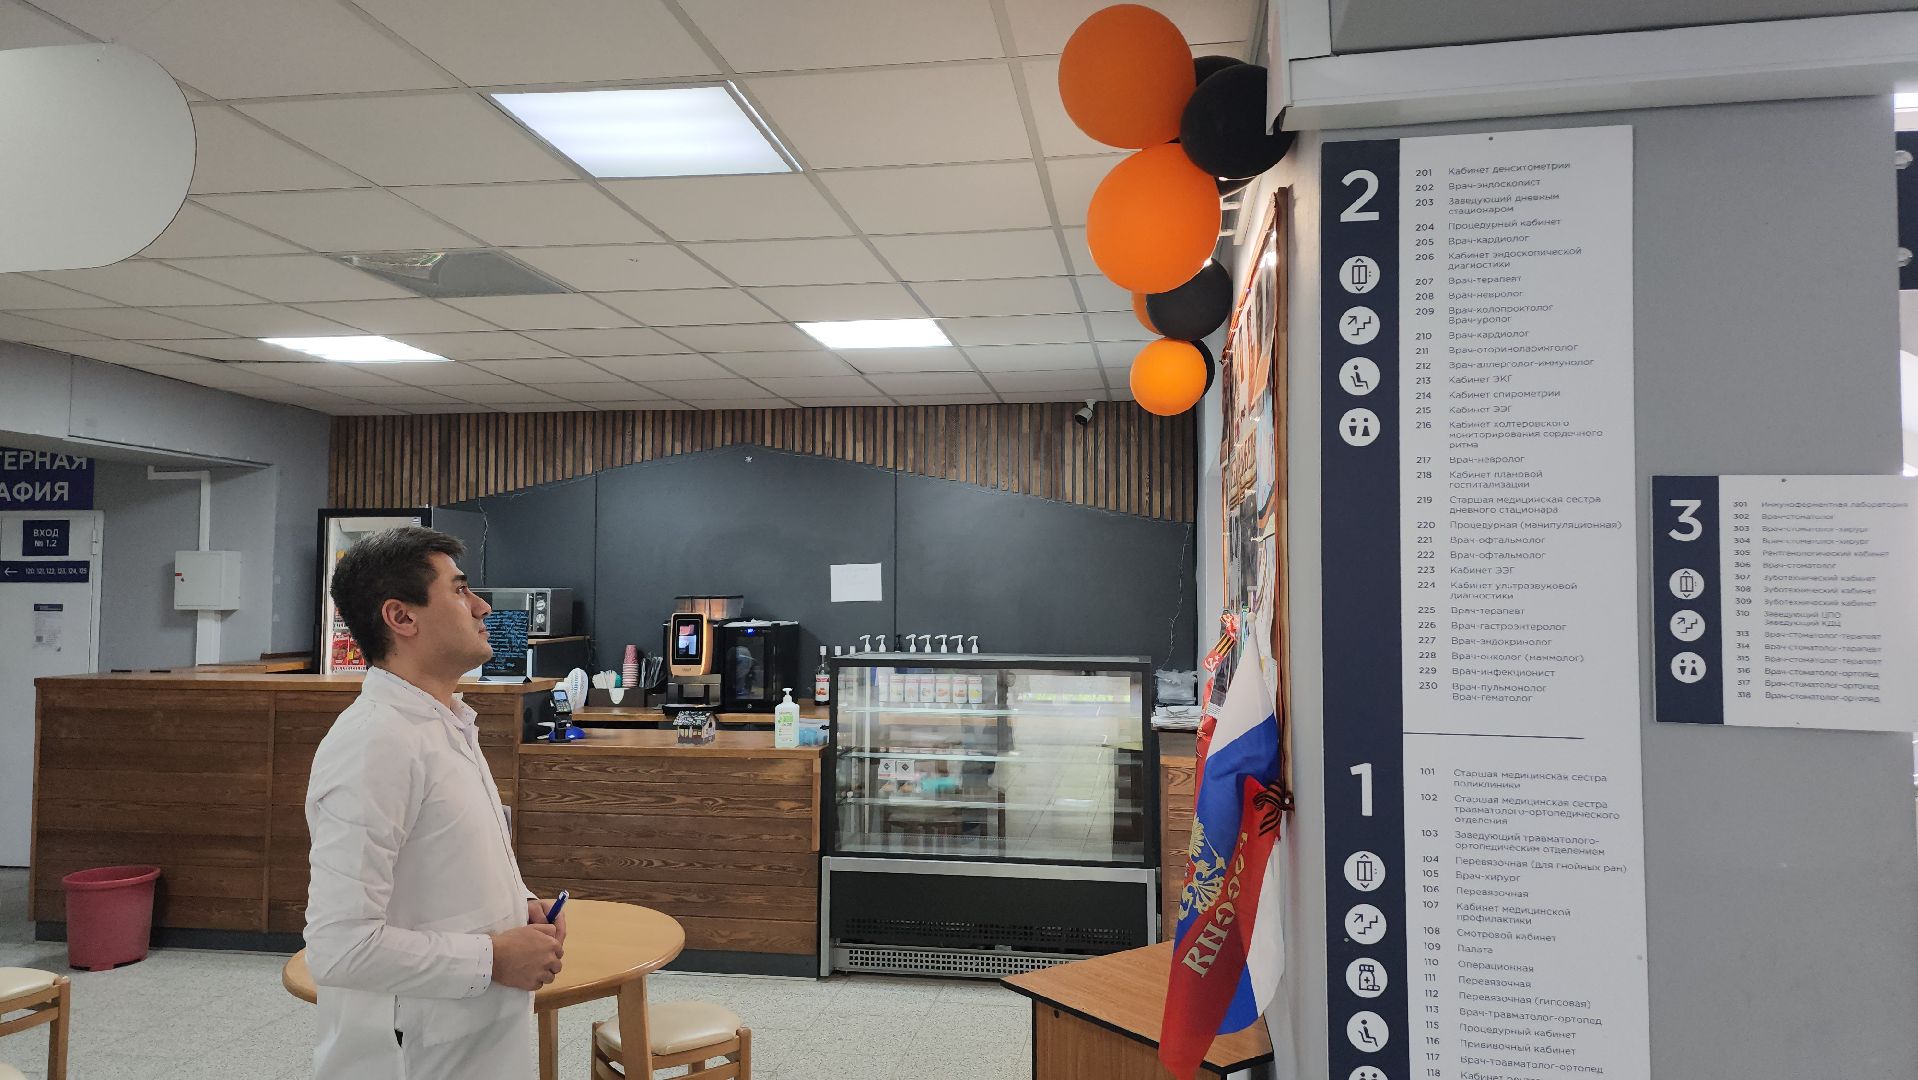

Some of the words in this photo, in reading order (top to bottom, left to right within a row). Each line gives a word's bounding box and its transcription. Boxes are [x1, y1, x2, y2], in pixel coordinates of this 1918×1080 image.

[1449, 167, 1489, 175] Кабинет
[1340, 170, 1380, 222] 2
[1416, 199, 1434, 207] 203
[1416, 223, 1434, 231] 204
[1449, 222, 1517, 231] Процедурный
[1416, 239, 1434, 247] 205
[1449, 236, 1530, 245] Врач-кардиолог
[1448, 262, 1510, 270] диагностики
[1448, 276, 1521, 285] Врач-терапевт
[1449, 292, 1523, 300] Врач-невролог
[1416, 308, 1435, 316] 209
[1449, 305, 1553, 315] Врач-колопроктолог
[1449, 316, 1512, 325] Врач-уролог
[1449, 331, 1528, 341] Врач-кардиолог
[1493, 375, 1512, 383] ЭКГ
[1449, 391, 1490, 399] Кабинет
[1493, 391, 1560, 399] спирометрии
[1416, 407, 1431, 415] 215
[1416, 421, 1431, 429] 216
[0, 451, 87, 470] ЕРНАЯ
[1494, 470, 1543, 478] плановой
[1450, 496, 1493, 504] Старшая
[1668, 500, 1703, 541] 3
[1450, 521, 1517, 530] Процедурная
[34, 529, 59, 537] ВХОД
[1450, 536, 1545, 544] Врач-офтальмолог
[1450, 551, 1546, 560] Врач-офтальмолог
[1450, 566, 1492, 574] Кабинет
[1451, 607, 1523, 615] Врач-терапевт
[1452, 637, 1552, 646] Врач-эндокринолог
[1524, 654, 1584, 663] (маммолог)
[1736, 655, 1750, 663] 315
[1452, 668, 1555, 677] Врач-инфекционист
[1453, 683, 1547, 692] Врач-пульмонолог
[1453, 693, 1533, 701] Врач-гематолог
[1454, 769, 1497, 778] Старшая
[1571, 775, 1607, 783] сестра
[1350, 763, 1373, 816] 1
[1421, 793, 1438, 801] 102
[1455, 795, 1498, 804] Старшая
[1502, 798, 1569, 807] медицинская
[1573, 801, 1608, 809] сестра
[1455, 831, 1520, 841] Заведующий
[1543, 847, 1604, 855] отделением
[1456, 857, 1527, 867] Перевязочная
[1556, 863, 1600, 871] гнойных
[1604, 865, 1626, 873] ран)
[1422, 870, 1438, 878] 105
[1456, 871, 1520, 882] Врач-хирург
[1457, 887, 1528, 897] Перевязочная
[1457, 903, 1498, 912] Кабинет
[1502, 907, 1570, 916] медицинской
[1457, 915, 1531, 924] профилактики
[1424, 927, 1440, 935] 108
[1457, 929, 1512, 939] Смотровой
[1516, 933, 1556, 942] кабинет
[1424, 942, 1440, 951] 109
[1458, 944, 1493, 953] Палата
[1425, 958, 1438, 966] 110
[1458, 960, 1533, 972] Операционная
[1424, 974, 1435, 982] 111
[1459, 976, 1531, 988] Перевязочная
[1425, 989, 1438, 998] 112
[1459, 992, 1531, 1004] Перевязочная
[1535, 997, 1590, 1009] (гипсовая)
[1425, 1005, 1439, 1013] 113
[1460, 1008, 1602, 1026] Врач-травматолог-ортопед
[1426, 1021, 1439, 1029] 115
[1460, 1023, 1531, 1035] Процедурный
[1534, 1030, 1576, 1039] кабинет
[1461, 1039, 1530, 1052] Прививочный
[1534, 1046, 1576, 1055] кабинет
[1461, 1056, 1603, 1074] Врач-травматолог-ортопед
[1427, 1069, 1440, 1077] 118
